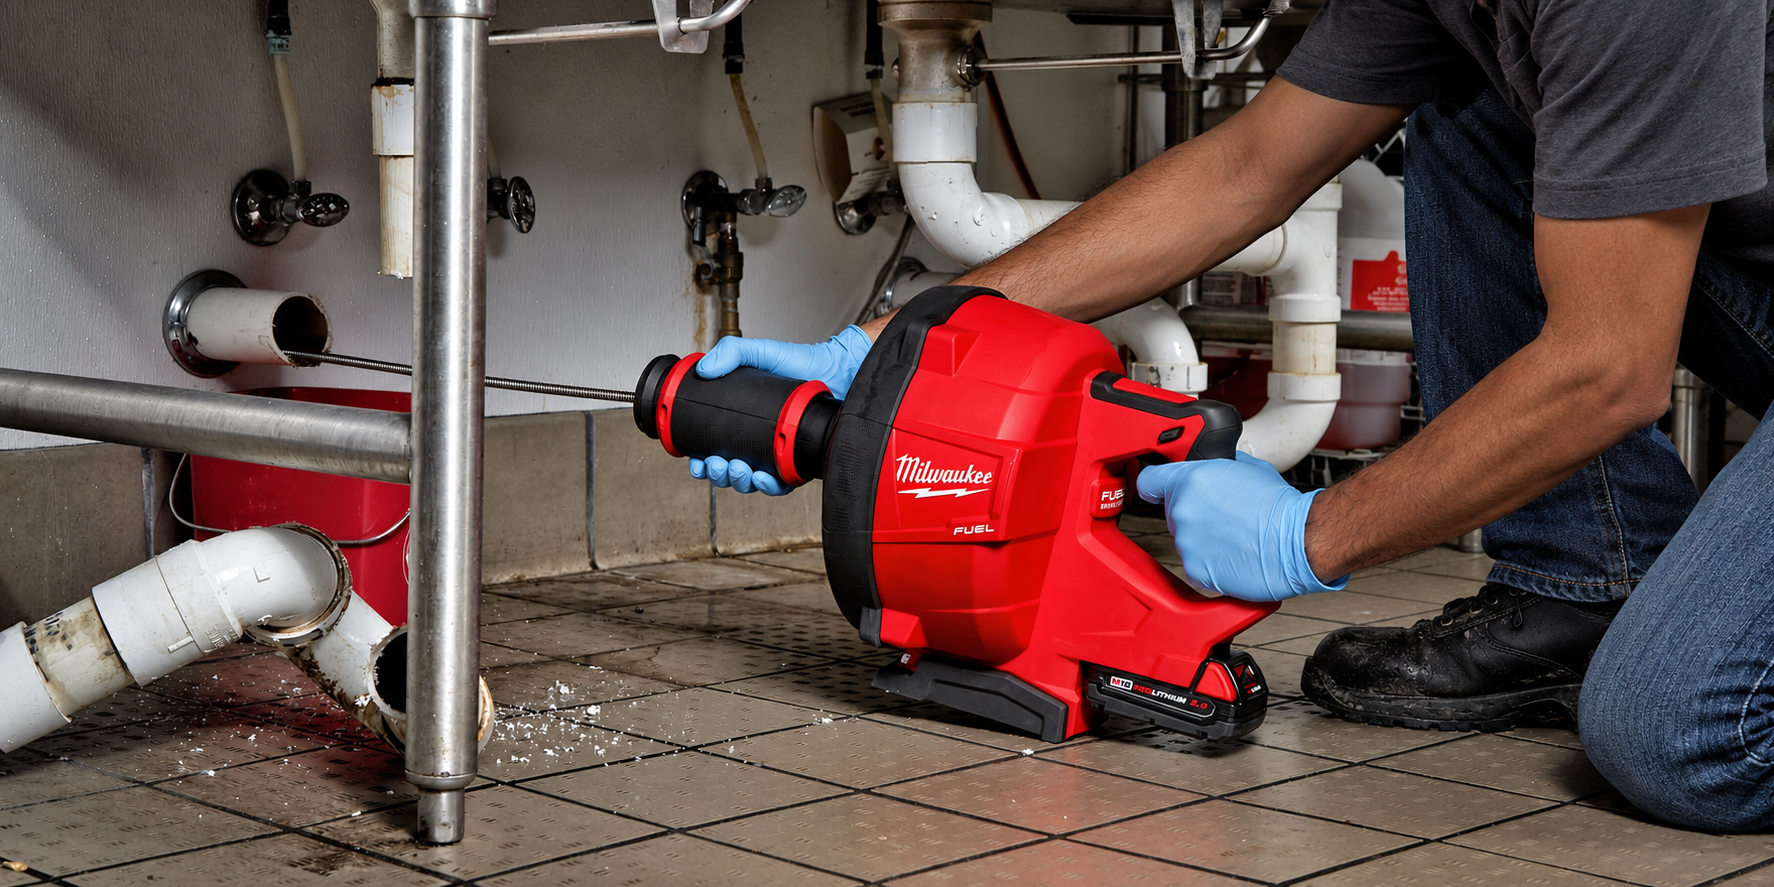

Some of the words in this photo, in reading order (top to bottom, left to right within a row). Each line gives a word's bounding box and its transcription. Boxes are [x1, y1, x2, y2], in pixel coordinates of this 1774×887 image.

[896, 454, 992, 484] Milwaukee
[953, 524, 994, 536] FUEL
[1190, 699, 1208, 710] 2.0
